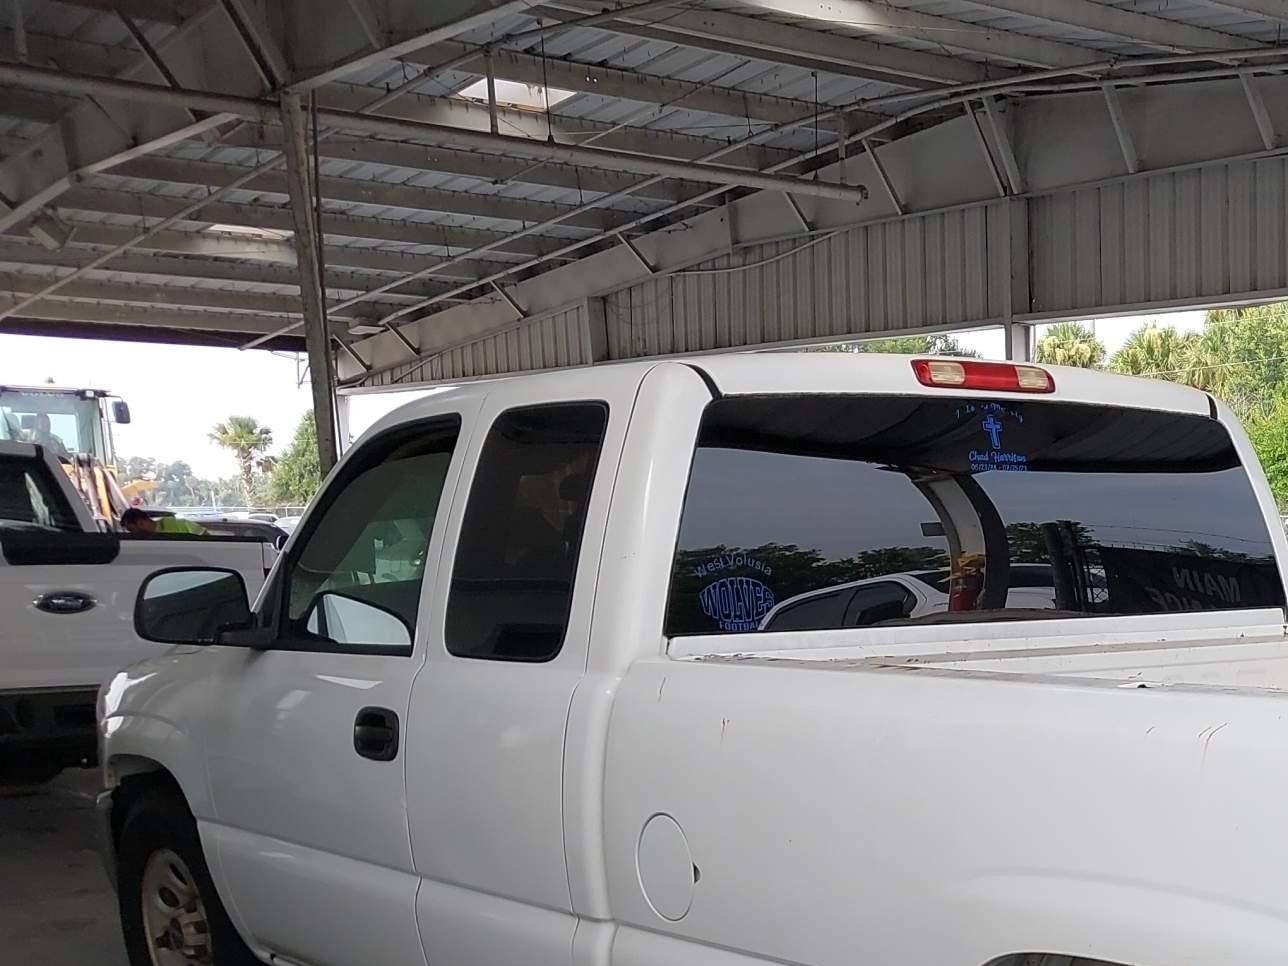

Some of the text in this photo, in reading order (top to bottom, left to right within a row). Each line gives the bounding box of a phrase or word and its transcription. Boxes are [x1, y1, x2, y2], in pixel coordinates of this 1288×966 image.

[726, 551, 773, 576] Volusia
[699, 577, 774, 622] WOLVES
[719, 620, 760, 631] FOOTBAL
